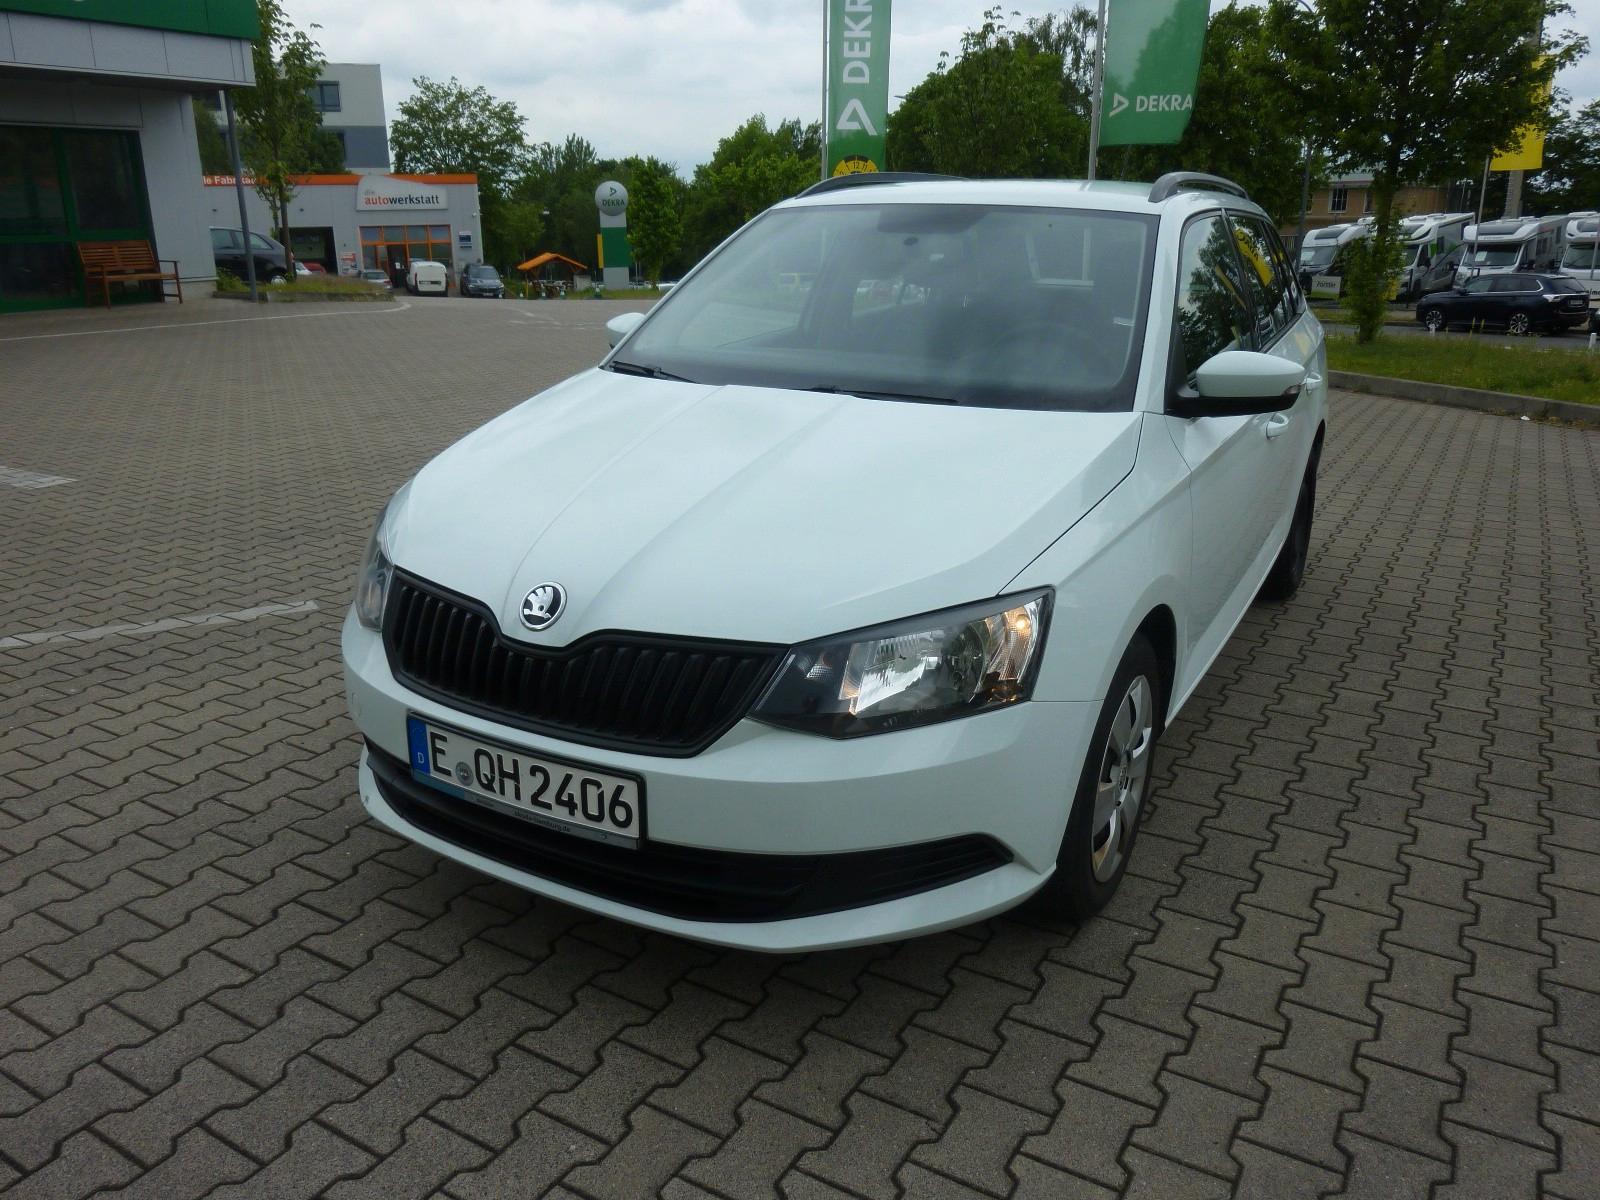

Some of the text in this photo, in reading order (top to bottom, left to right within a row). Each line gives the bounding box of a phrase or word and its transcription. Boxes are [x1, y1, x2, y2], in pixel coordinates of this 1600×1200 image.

[1135, 94, 1193, 112] DEKRA
[364, 194, 440, 206] autowerkstatt
[602, 199, 625, 208] DEKRA
[417, 752, 425, 764] D
[430, 731, 452, 777] E
[529, 764, 634, 829] 2406
